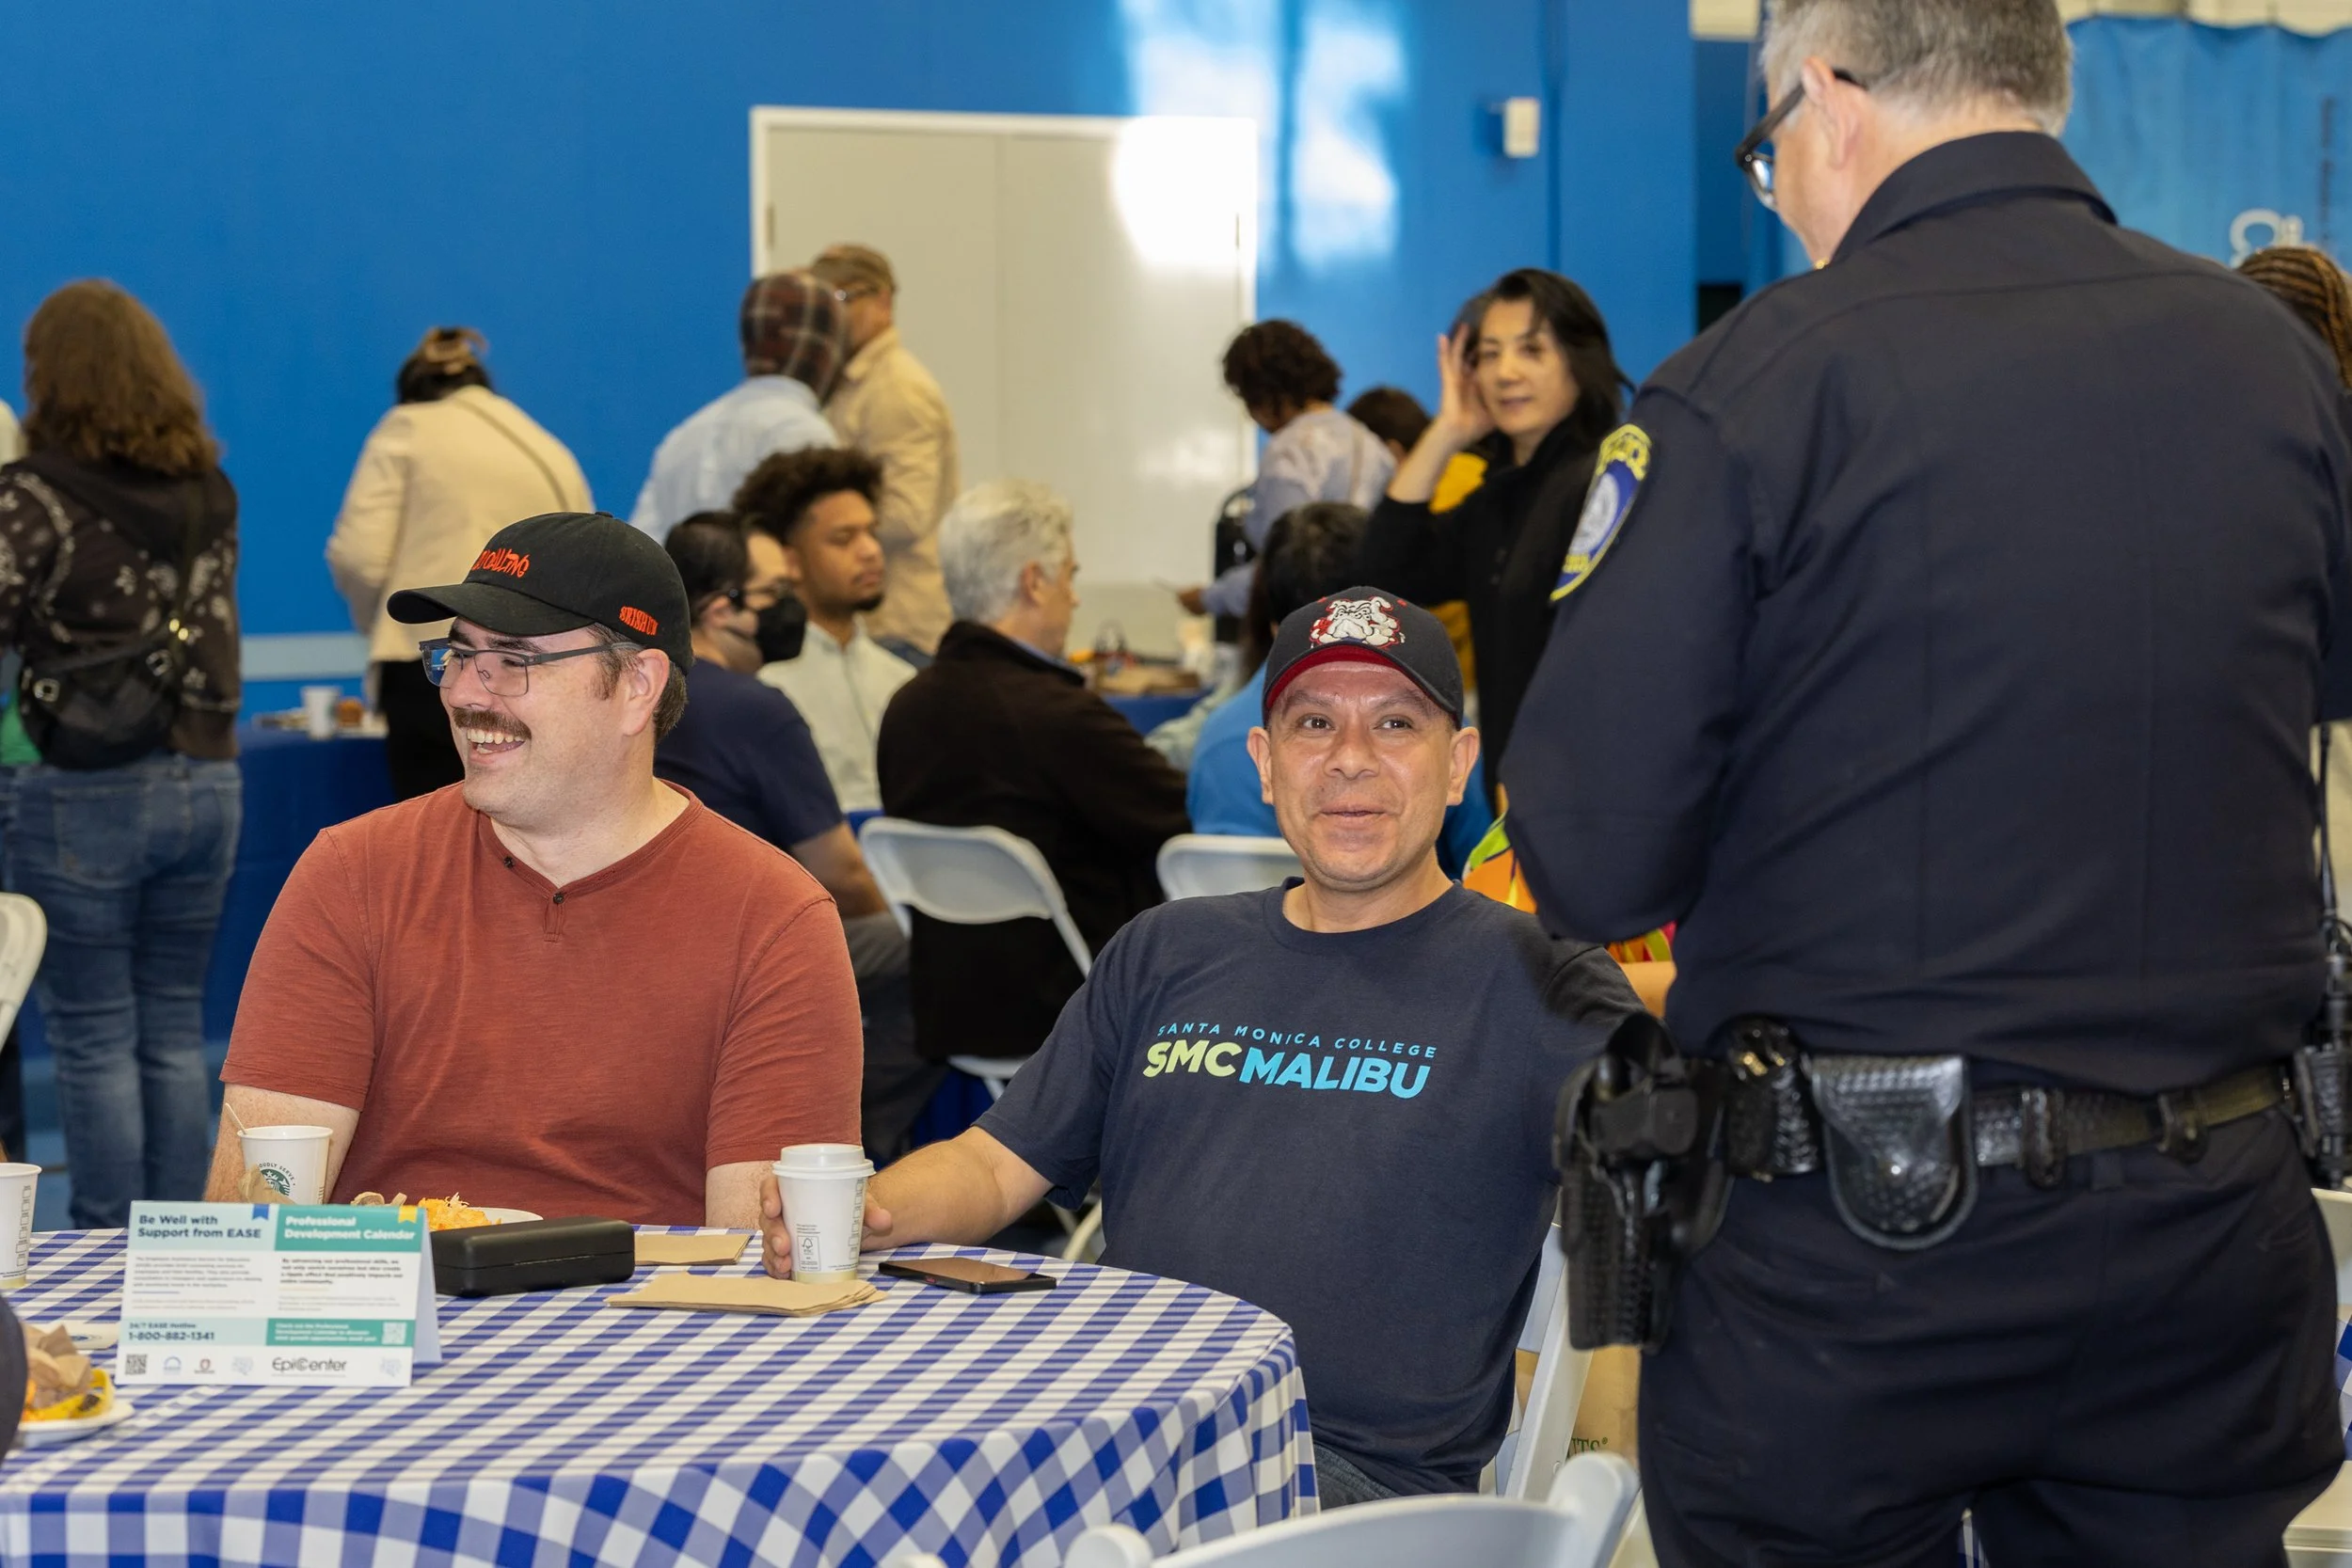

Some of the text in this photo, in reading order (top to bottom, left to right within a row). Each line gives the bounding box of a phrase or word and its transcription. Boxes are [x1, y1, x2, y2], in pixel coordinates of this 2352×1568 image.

[1157, 1022, 1436, 1058] SANTA MONICA COLLEGE
[1142, 1038, 1431, 1099] SMC MALIBU
[138, 1215, 218, 1225] Be Well with
[285, 1216, 356, 1226] Professional
[137, 1227, 262, 1239] Support from EASE
[284, 1228, 415, 1240] Development Calendar
